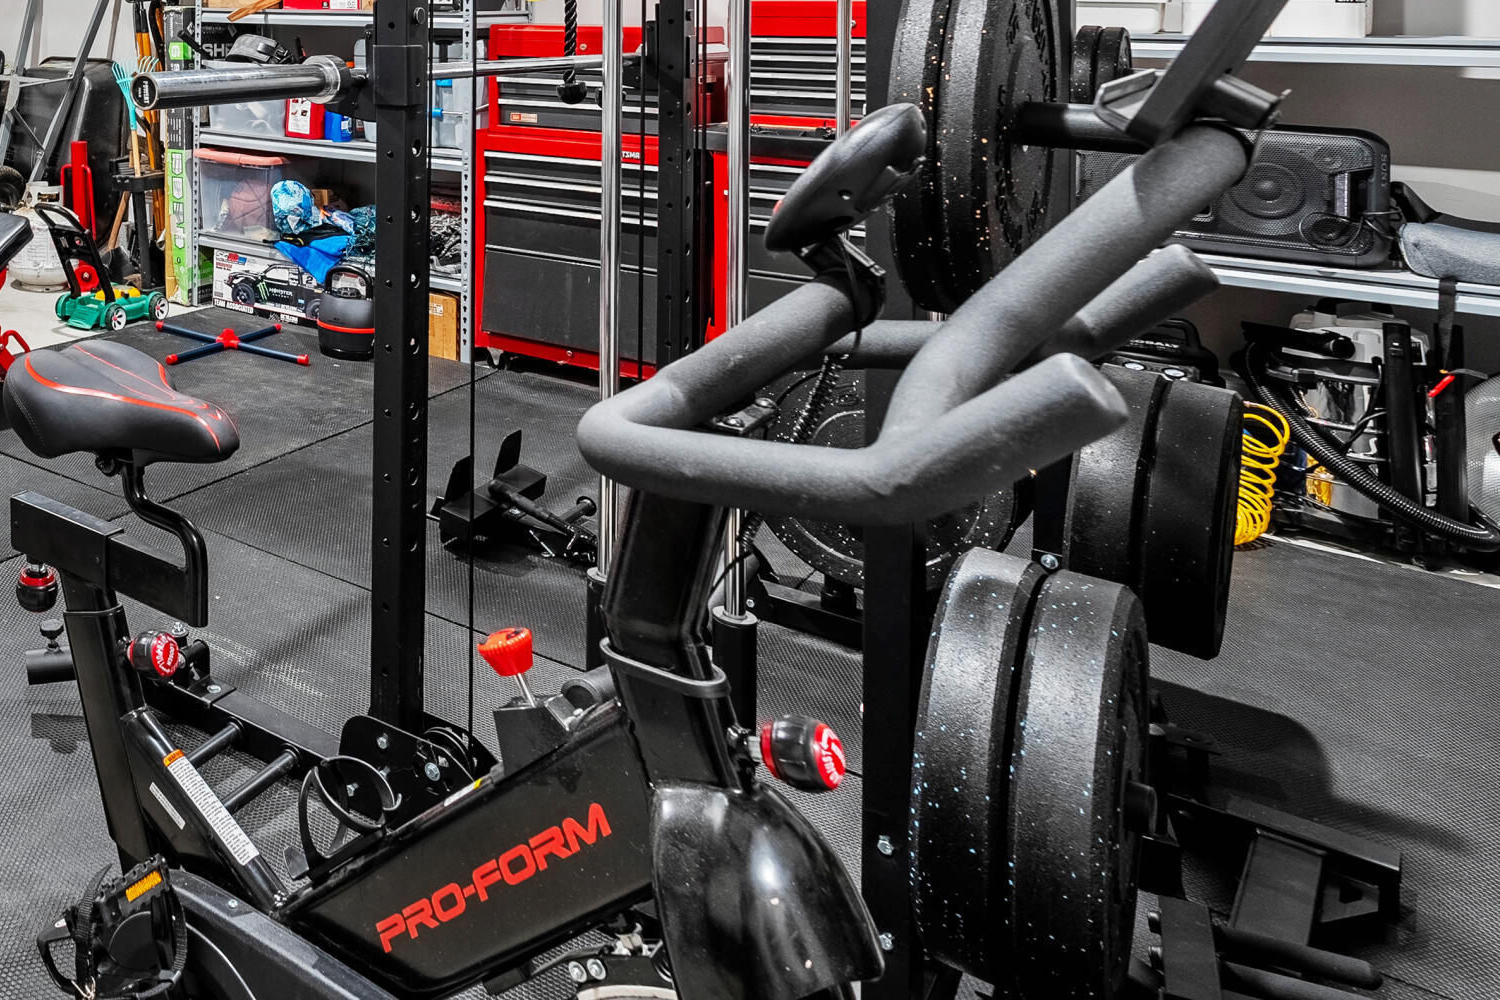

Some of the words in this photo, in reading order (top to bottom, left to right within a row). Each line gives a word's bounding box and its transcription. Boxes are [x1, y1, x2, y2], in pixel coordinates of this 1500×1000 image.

[214, 299, 226, 308] TEAM
[227, 301, 254, 314] ASSOCIATED
[375, 802, 612, 953] PRO-FORM
